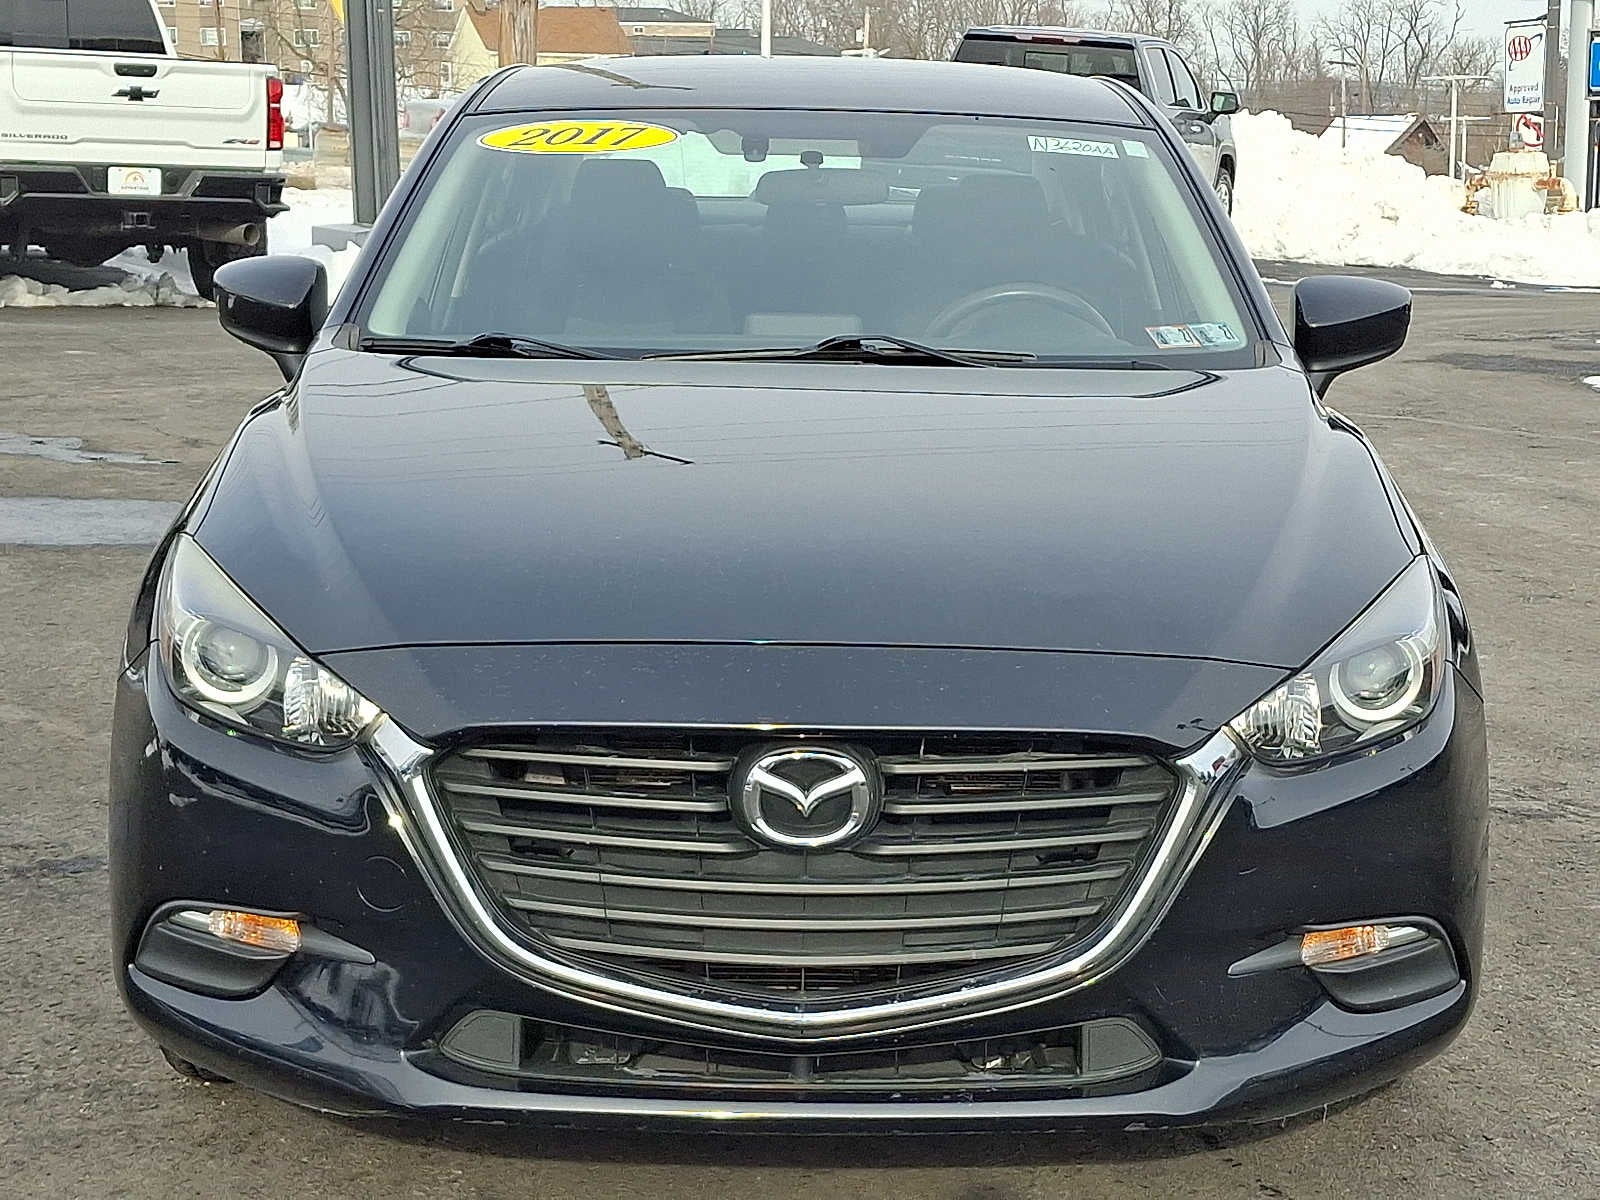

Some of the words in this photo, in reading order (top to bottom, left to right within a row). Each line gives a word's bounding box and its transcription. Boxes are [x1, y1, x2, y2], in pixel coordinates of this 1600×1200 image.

[1509, 83, 1539, 95] Approved
[1507, 96, 1521, 105] Auto
[1522, 95, 1541, 105] Repair
[0, 132, 69, 141] SILVERADO
[507, 126, 649, 147] 2017
